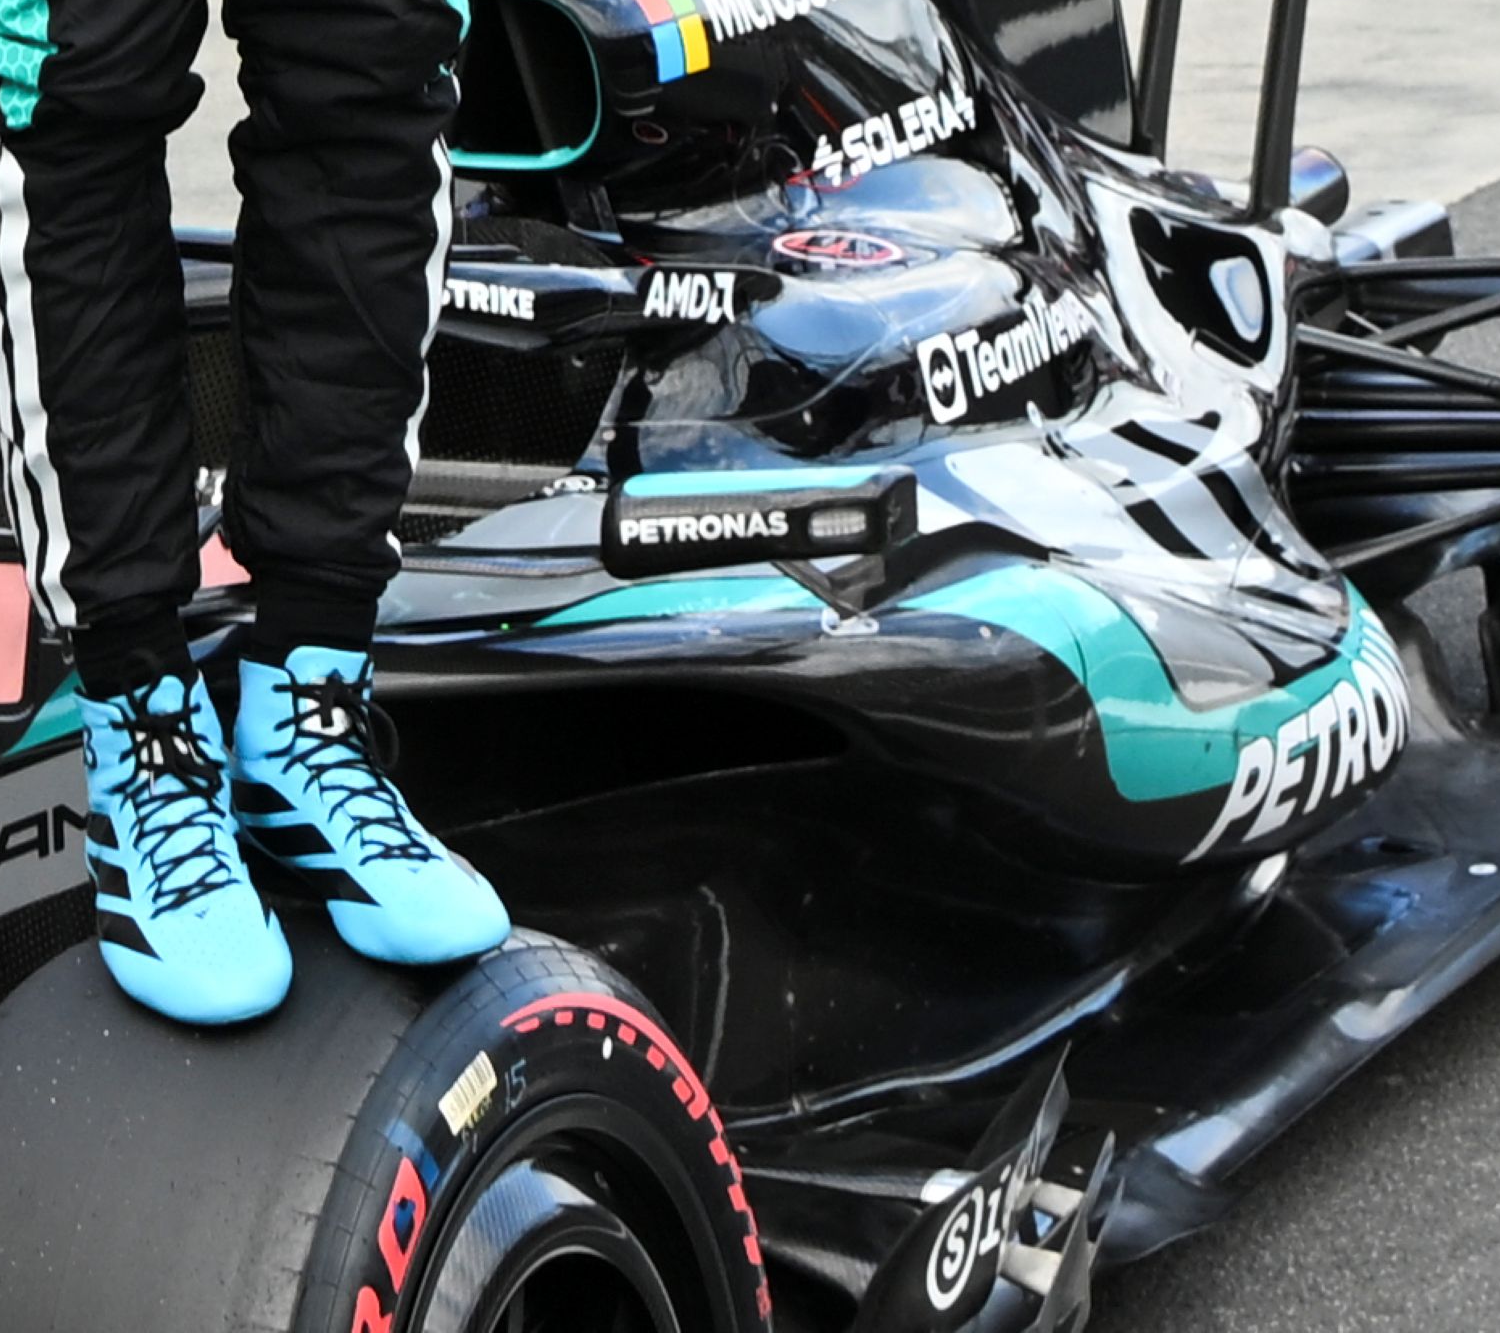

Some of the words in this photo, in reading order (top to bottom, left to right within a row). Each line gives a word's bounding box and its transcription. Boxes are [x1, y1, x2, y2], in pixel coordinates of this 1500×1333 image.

[840, 87, 955, 181] SOLERA
[643, 271, 709, 319] AMD
[620, 509, 789, 545] PETRONAS
